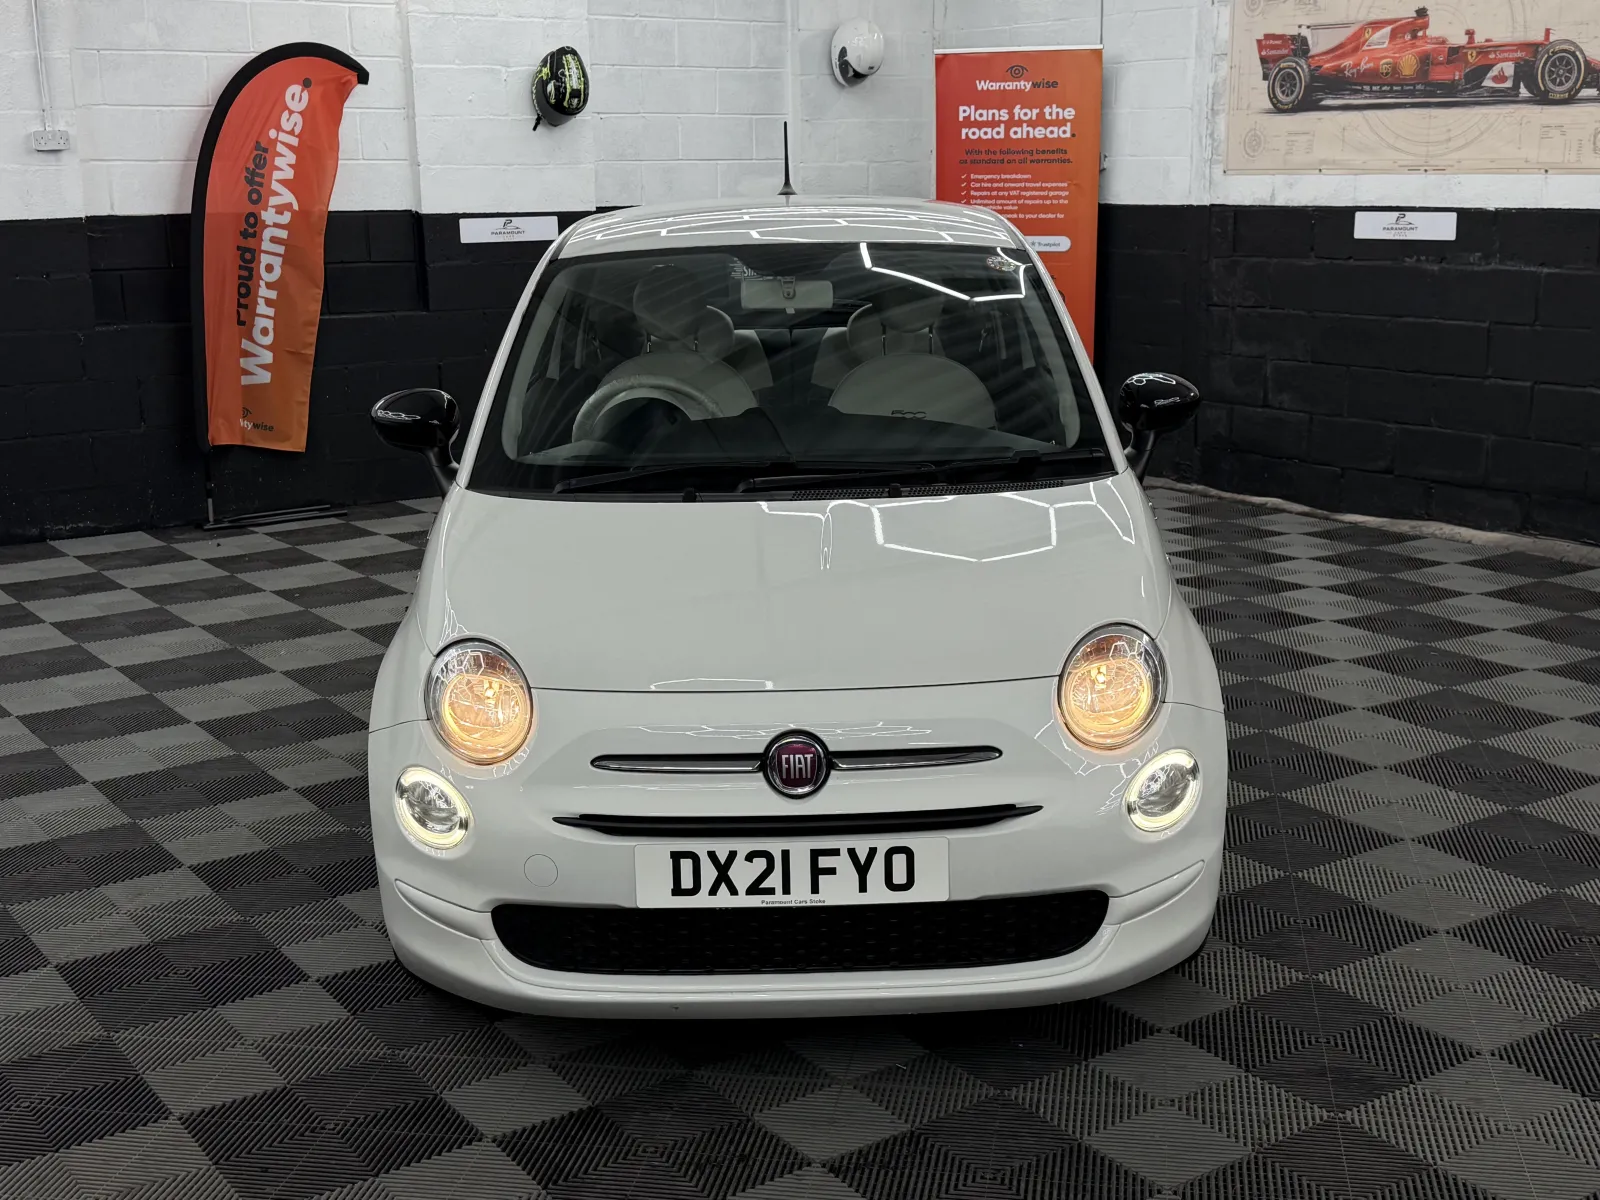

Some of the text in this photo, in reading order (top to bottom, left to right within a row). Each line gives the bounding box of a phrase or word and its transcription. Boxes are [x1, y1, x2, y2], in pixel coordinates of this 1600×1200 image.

[1495, 51, 1526, 59] Santander
[975, 78, 1059, 92] Warrantywise
[958, 103, 1076, 121] Plans for the
[961, 122, 1077, 140] road ahead.
[999, 148, 1034, 156] following
[244, 140, 269, 206] offer
[239, 211, 259, 240] to
[240, 77, 312, 385] Warrantywise.
[781, 753, 814, 779] FIAT
[669, 845, 916, 897] DX21 FYO
